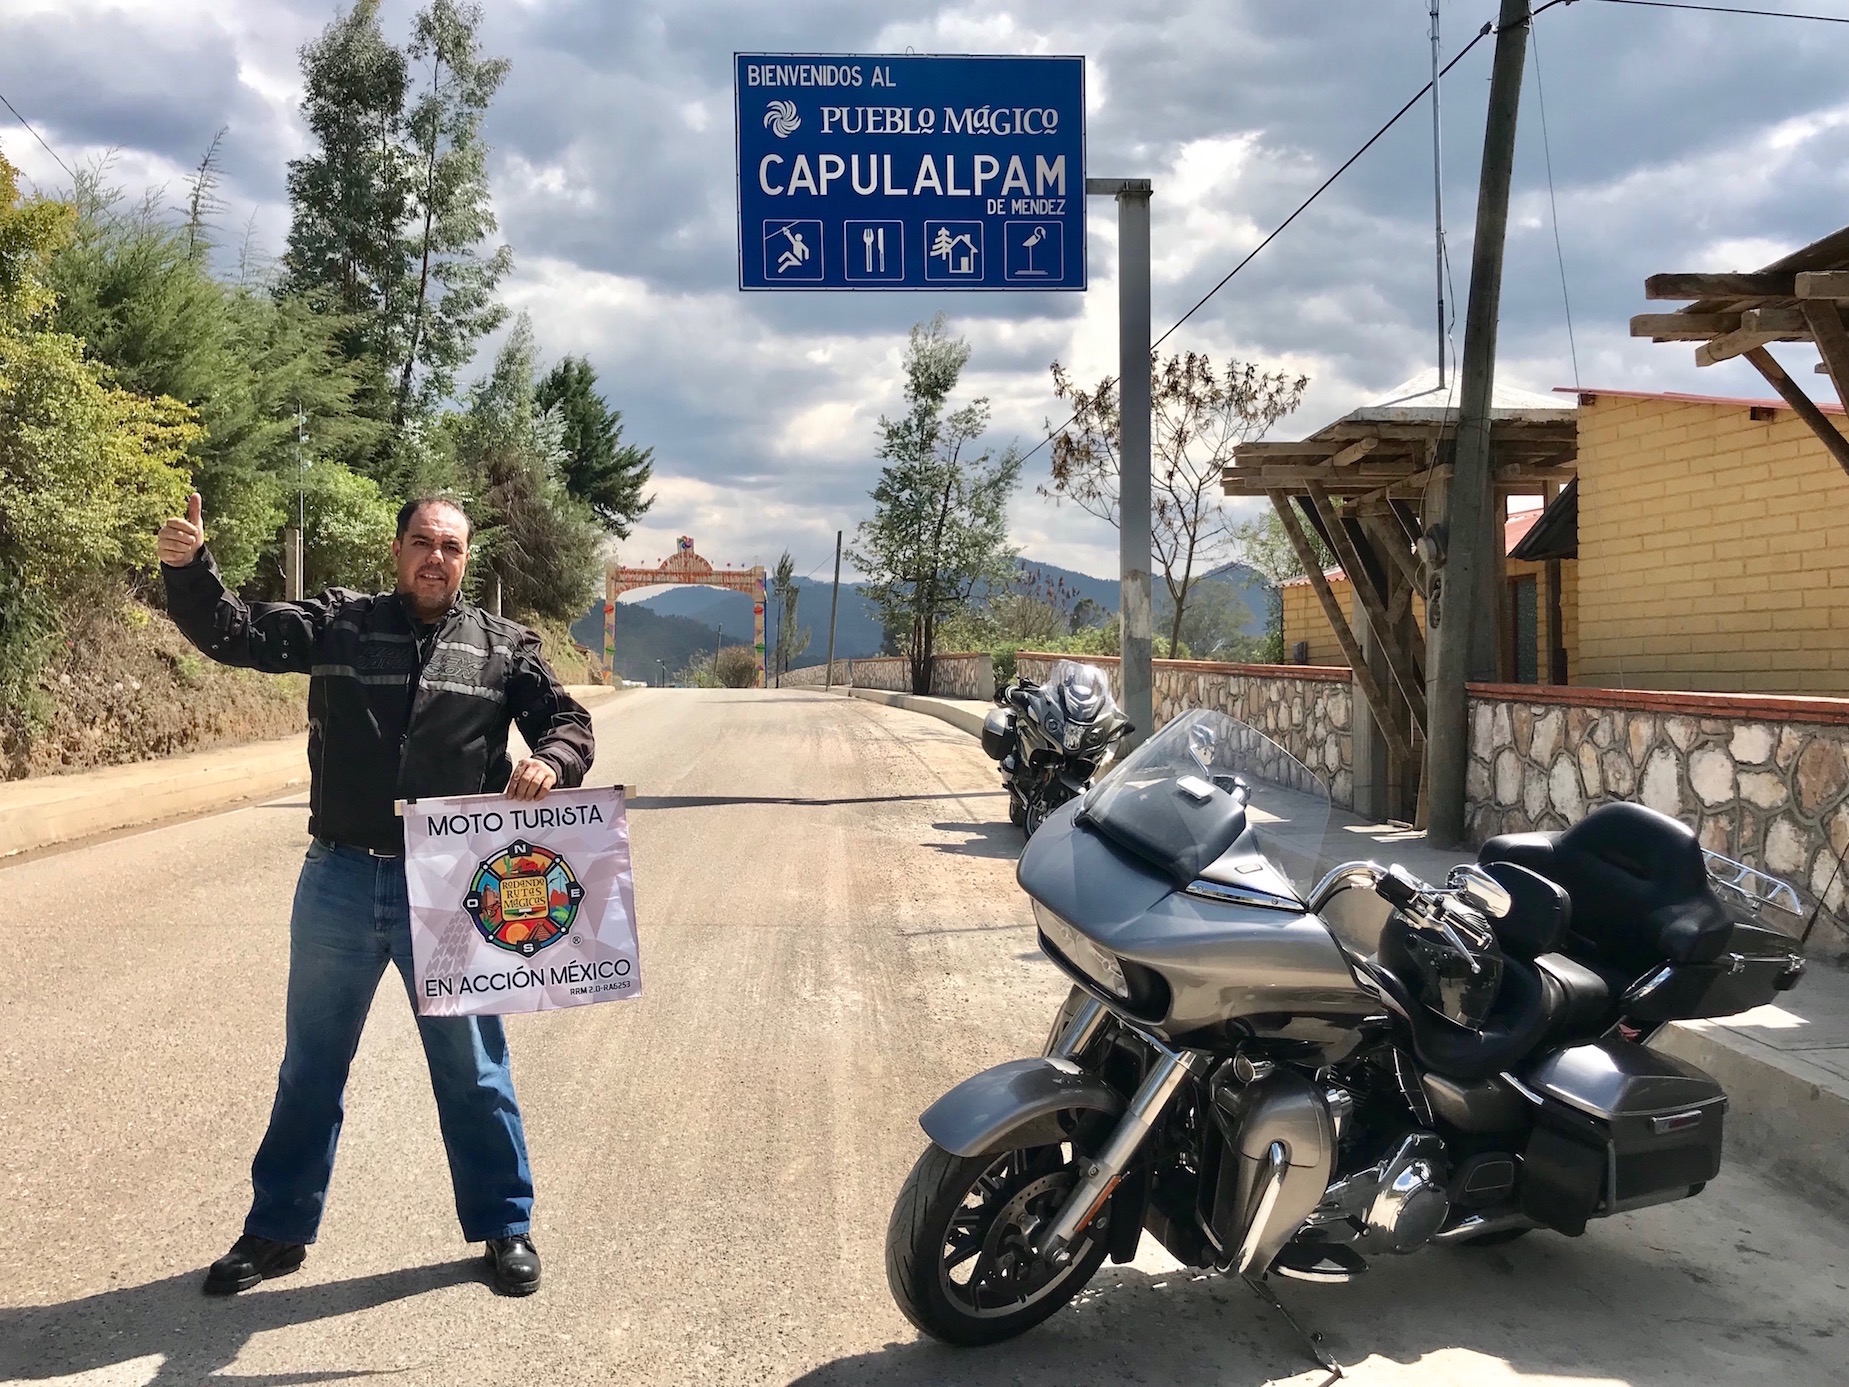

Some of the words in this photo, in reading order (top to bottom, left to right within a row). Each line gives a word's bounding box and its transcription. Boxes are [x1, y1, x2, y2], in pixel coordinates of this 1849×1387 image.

[747, 65, 863, 87] BIENVENIDOS
[871, 65, 896, 88] AL
[758, 154, 1066, 196] CAPULALPAM
[987, 199, 1006, 215] DE
[1010, 199, 1066, 215] MENDEZ
[427, 812, 503, 836] MOTO
[510, 804, 603, 829] TURISTA
[514, 844, 527, 853] N
[570, 888, 581, 898] E
[522, 942, 534, 952] S
[425, 978, 452, 997] EN
[459, 965, 545, 996] ACCIÓN
[551, 959, 631, 986] MÉXICO
[570, 986, 588, 995] RRM
